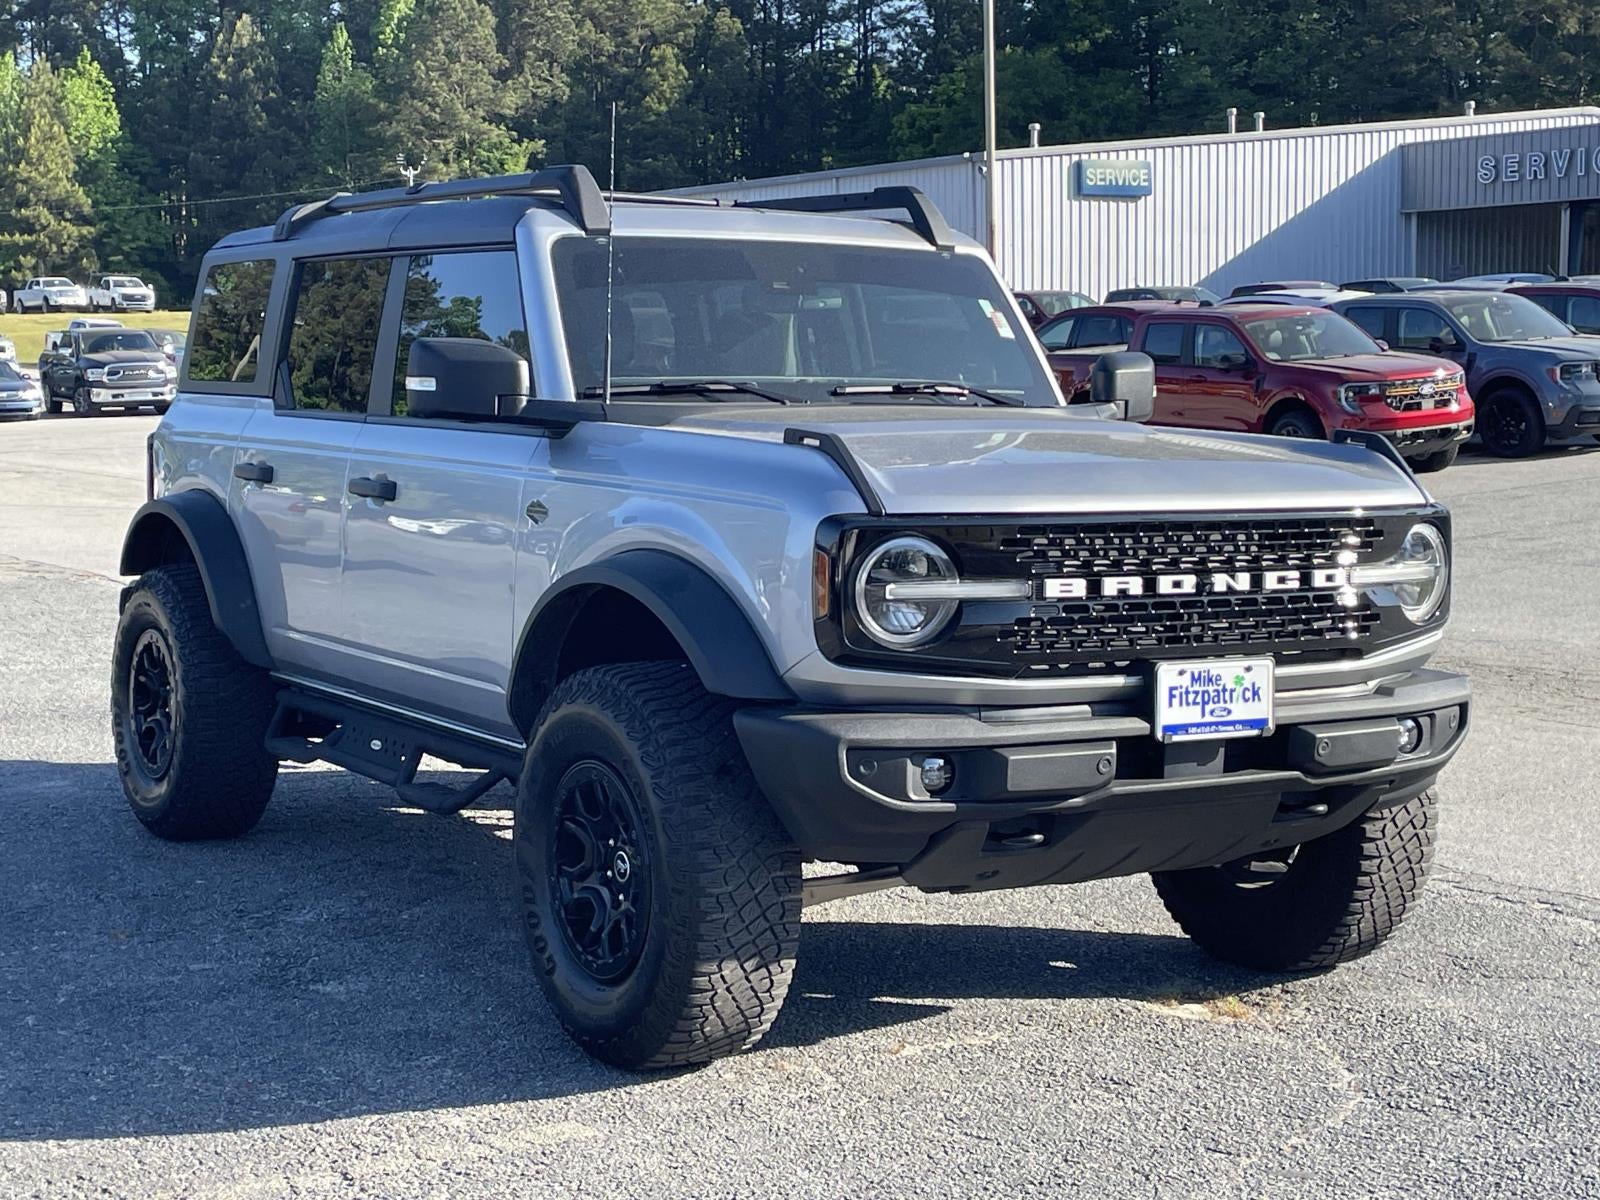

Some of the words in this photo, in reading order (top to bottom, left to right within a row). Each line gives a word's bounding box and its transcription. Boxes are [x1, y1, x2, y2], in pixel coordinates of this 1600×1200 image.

[1086, 167, 1149, 186] SERVICE
[1043, 569, 1346, 599] BRONCO
[1190, 668, 1223, 688] Mike
[1168, 675, 1262, 719] Fitzpatrick
